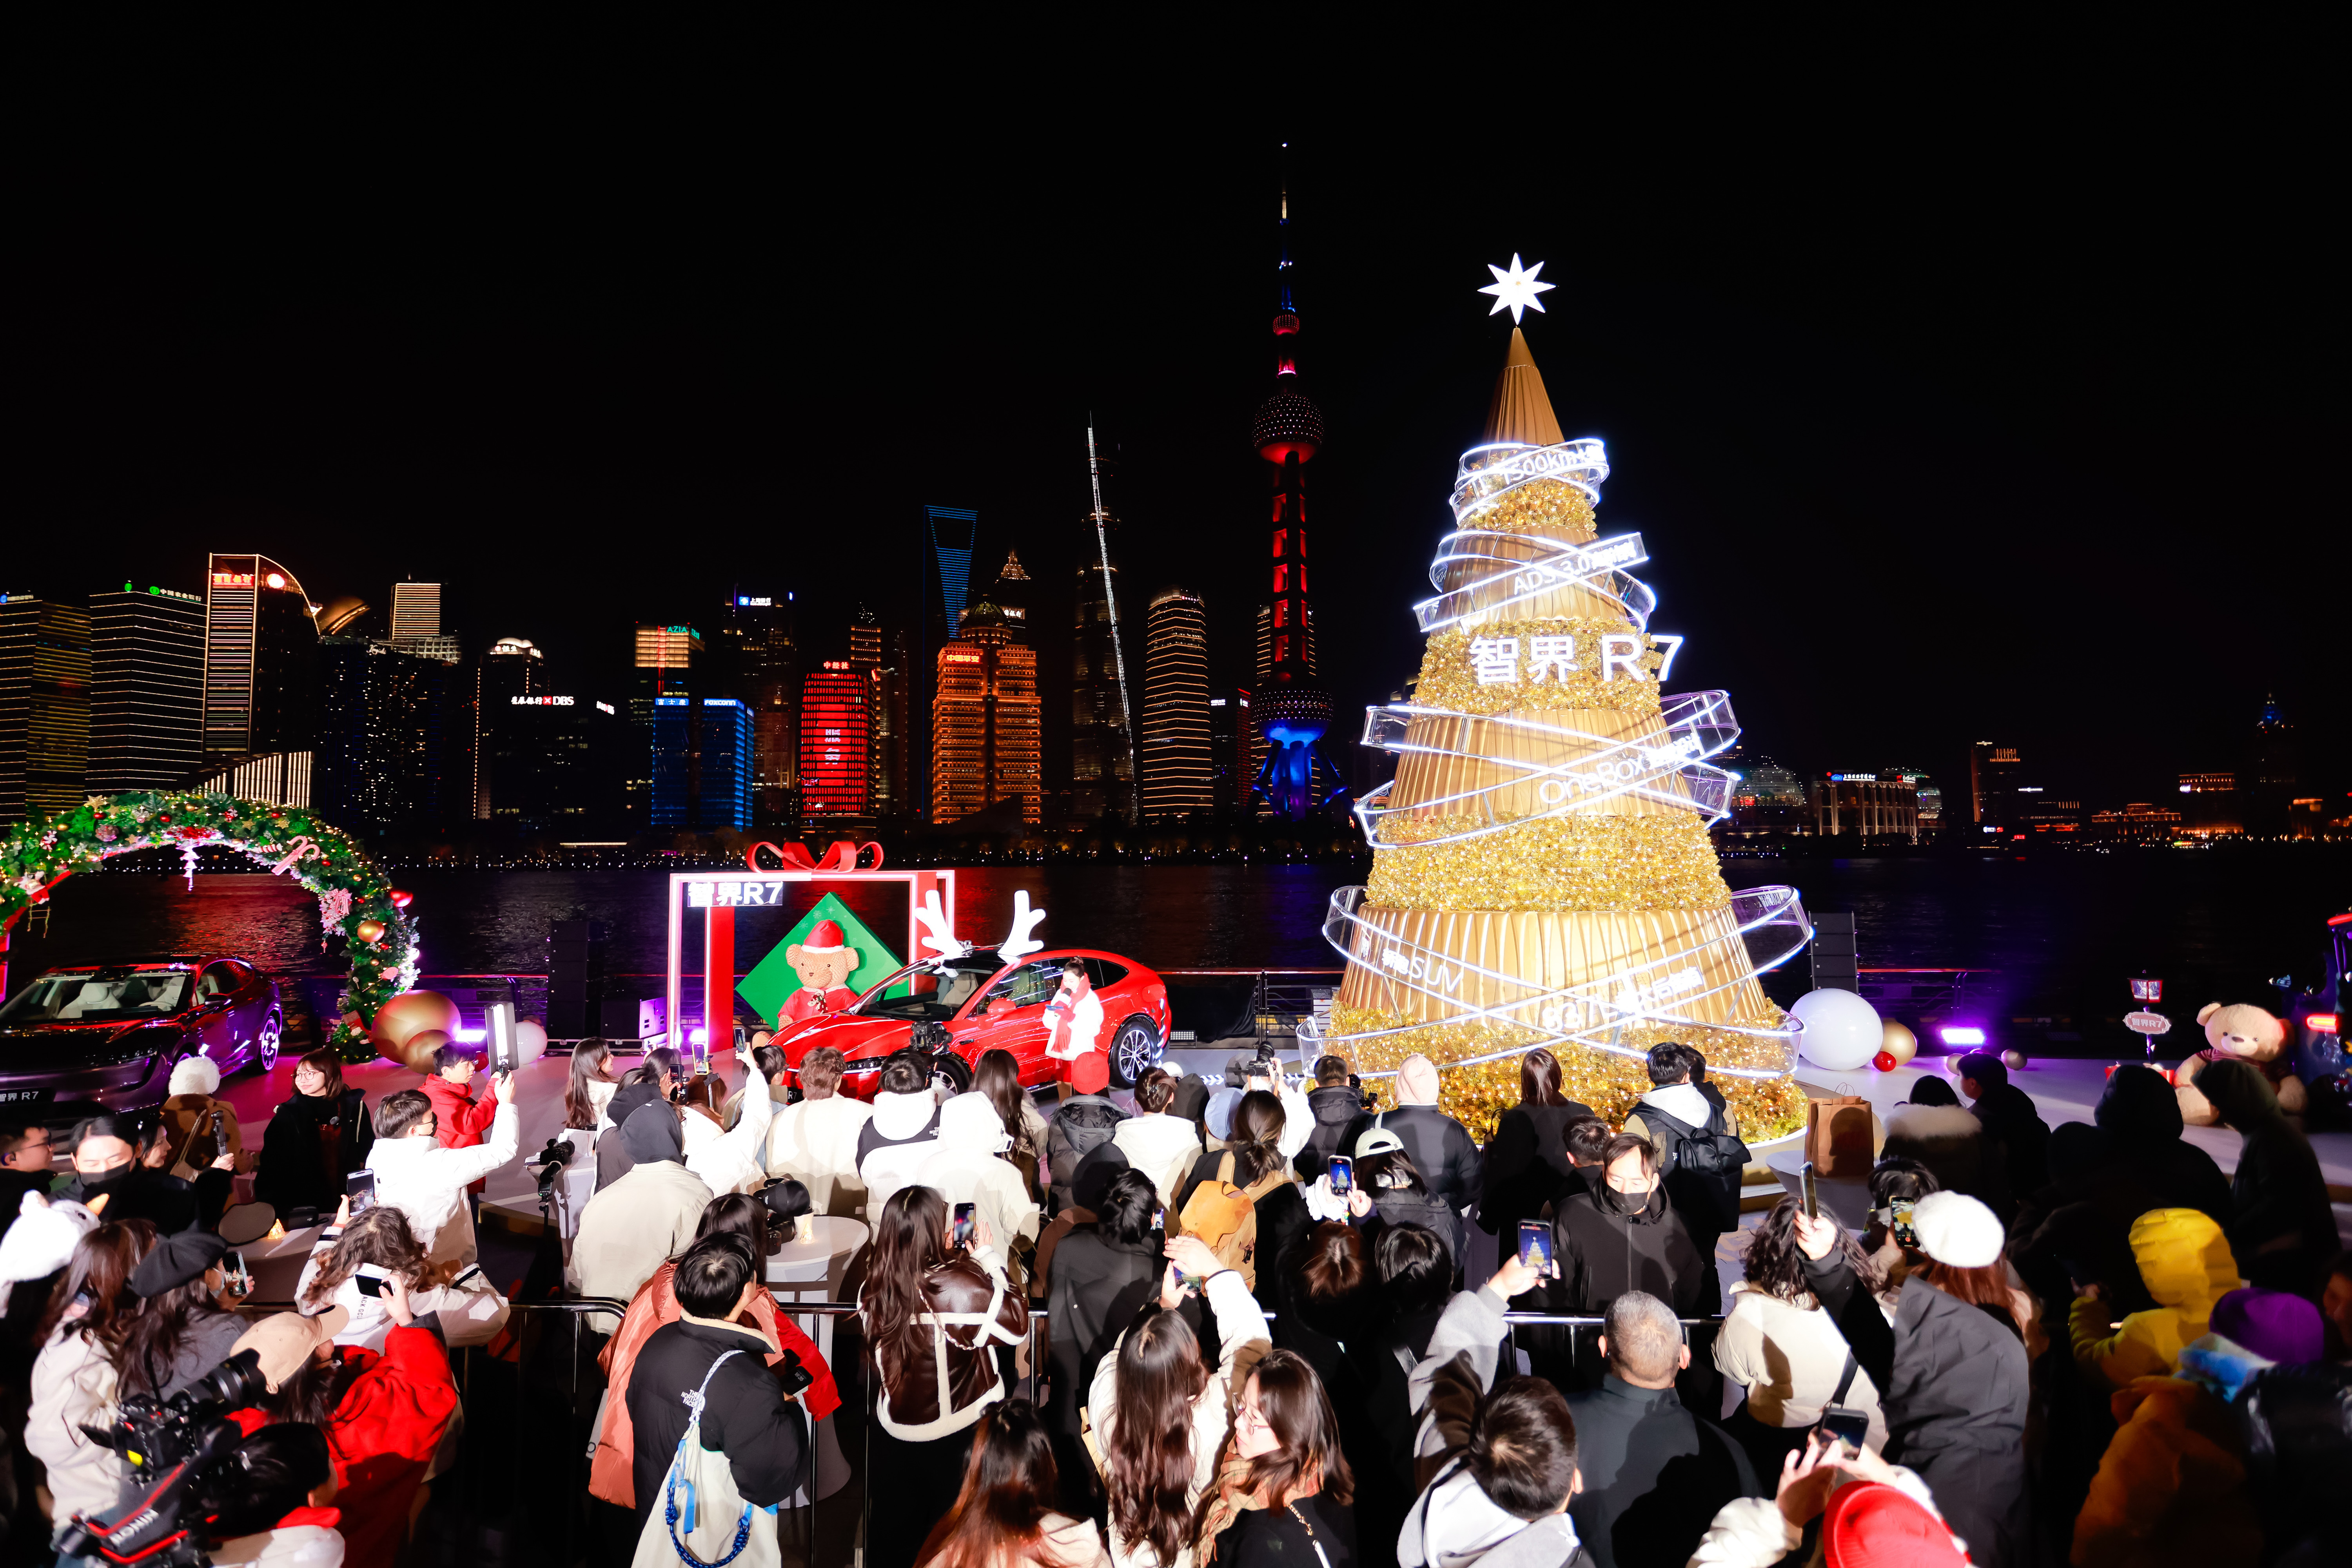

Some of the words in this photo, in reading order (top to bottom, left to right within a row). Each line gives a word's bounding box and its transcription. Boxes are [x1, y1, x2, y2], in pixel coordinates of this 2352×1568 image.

[160, 589, 202, 602] 中国农业银行
[824, 661, 849, 669] 中经社
[1470, 635, 1578, 685] 智界
[1601, 635, 1684, 682] R7
[553, 696, 574, 705] DBS
[688, 881, 783, 906] 智界R7
[2131, 1018, 2163, 1028] 智界R7
[22, 1091, 39, 1100] R7
[689, 1389, 699, 1398] THE
[683, 1398, 695, 1408] FACE
